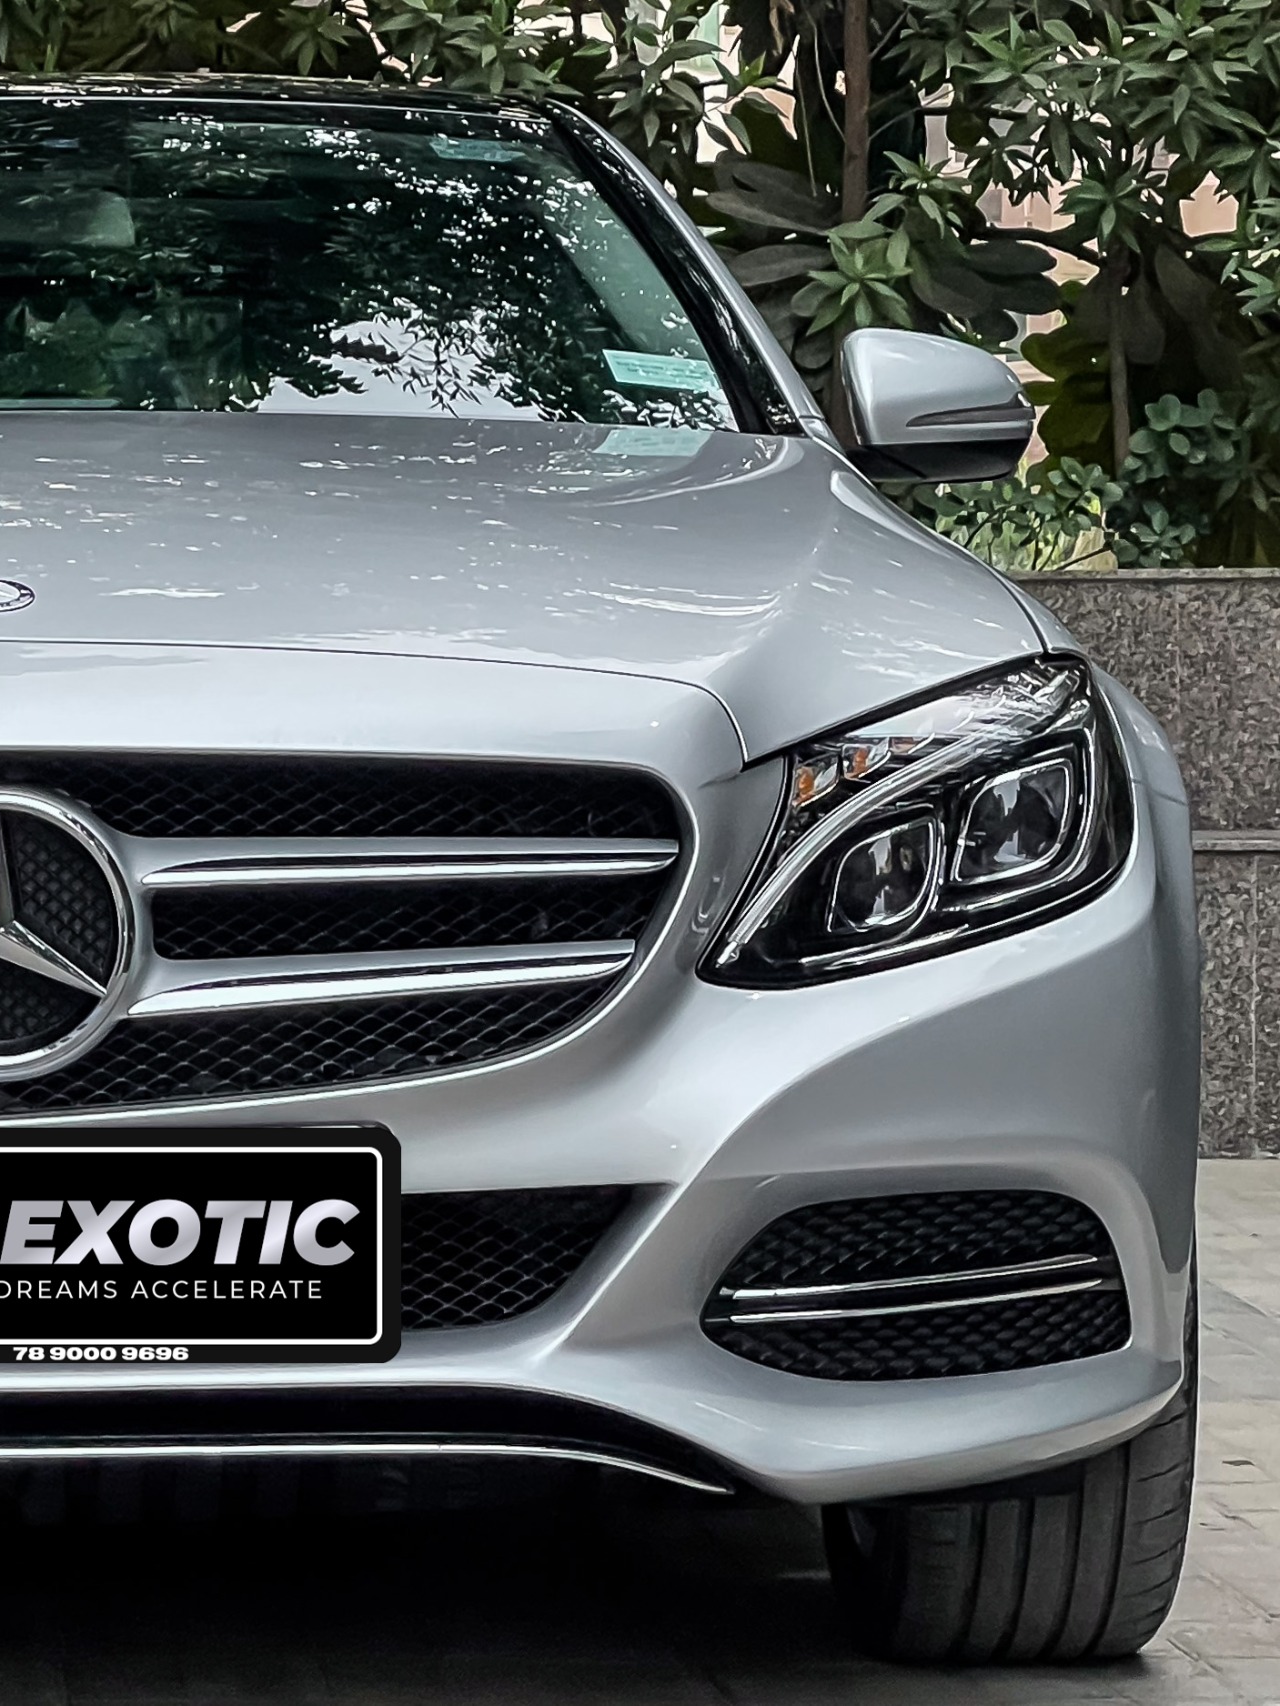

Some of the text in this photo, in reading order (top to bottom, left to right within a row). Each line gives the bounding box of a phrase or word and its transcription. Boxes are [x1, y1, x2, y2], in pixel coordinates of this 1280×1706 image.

[131, 1280, 322, 1299] ACCELERATE
[13, 1347, 45, 1361] 78
[50, 1347, 117, 1361] 9000
[121, 1347, 190, 1361] 9696
